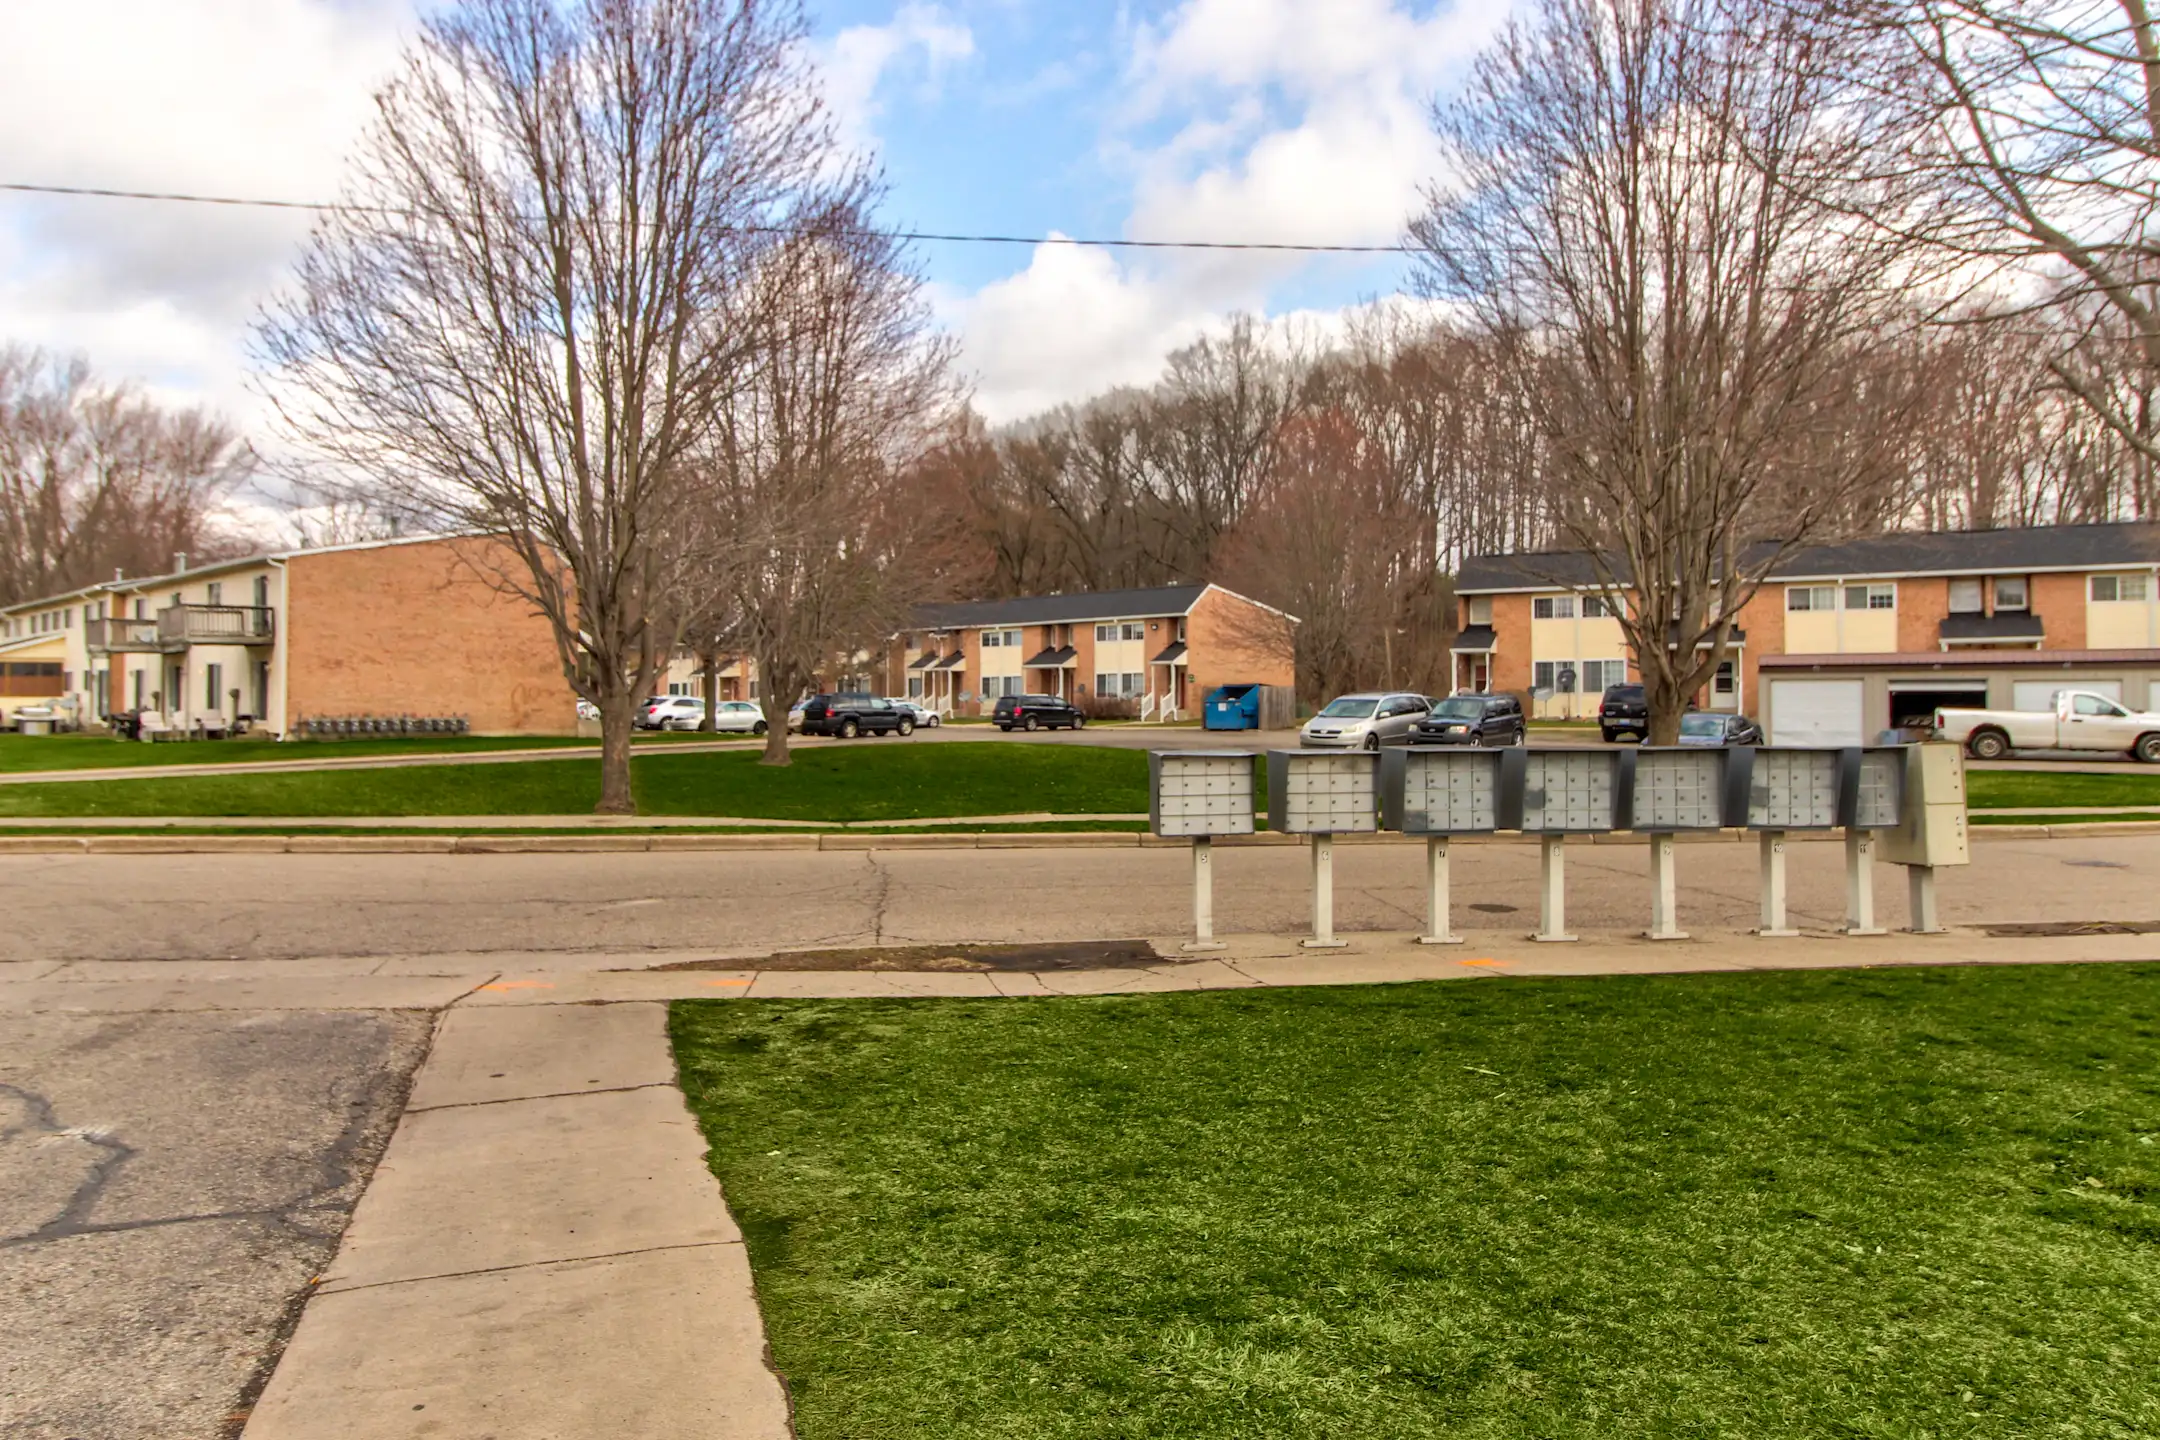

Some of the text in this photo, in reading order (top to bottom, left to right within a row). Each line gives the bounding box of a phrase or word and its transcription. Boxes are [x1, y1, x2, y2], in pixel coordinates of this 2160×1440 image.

[1554, 847, 1560, 856] 8
[1774, 844, 1784, 853] 10
[1860, 844, 1868, 853] 11
[1322, 851, 1329, 860] 6
[1439, 849, 1446, 858] 7
[1201, 854, 1208, 863] 5
